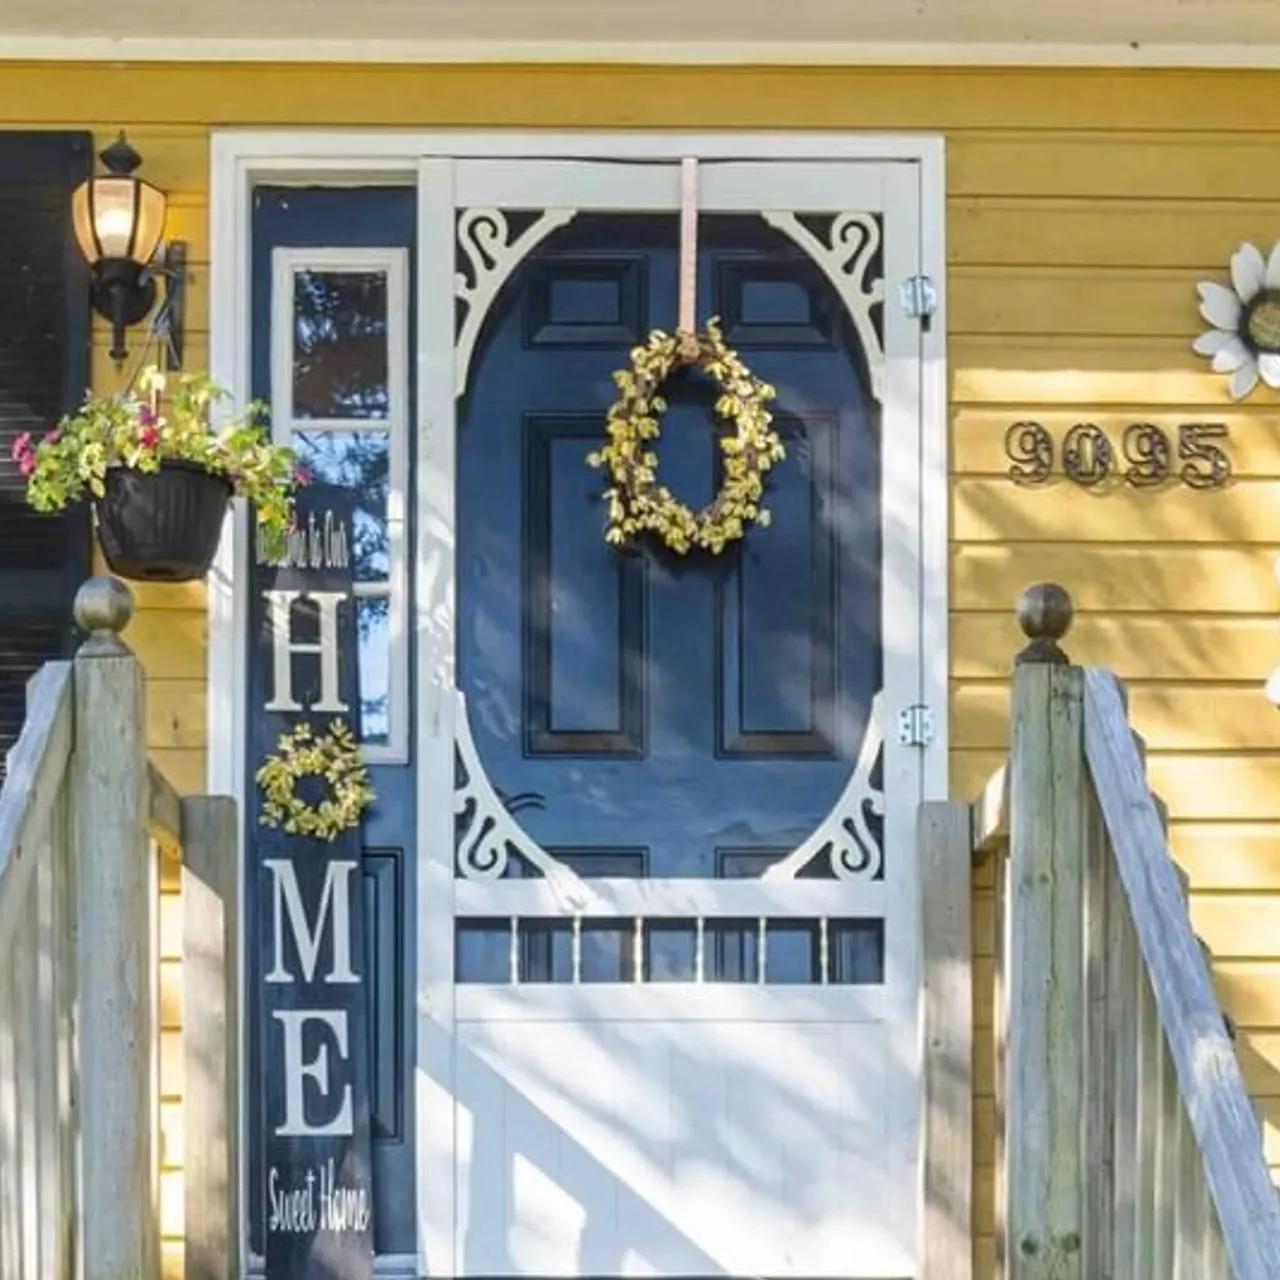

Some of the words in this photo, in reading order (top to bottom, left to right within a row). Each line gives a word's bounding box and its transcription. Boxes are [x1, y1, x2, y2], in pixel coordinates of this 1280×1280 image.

[1004, 420, 1232, 489] 9095
[268, 1167, 317, 1232] Sweet
[319, 1157, 370, 1232] Home
